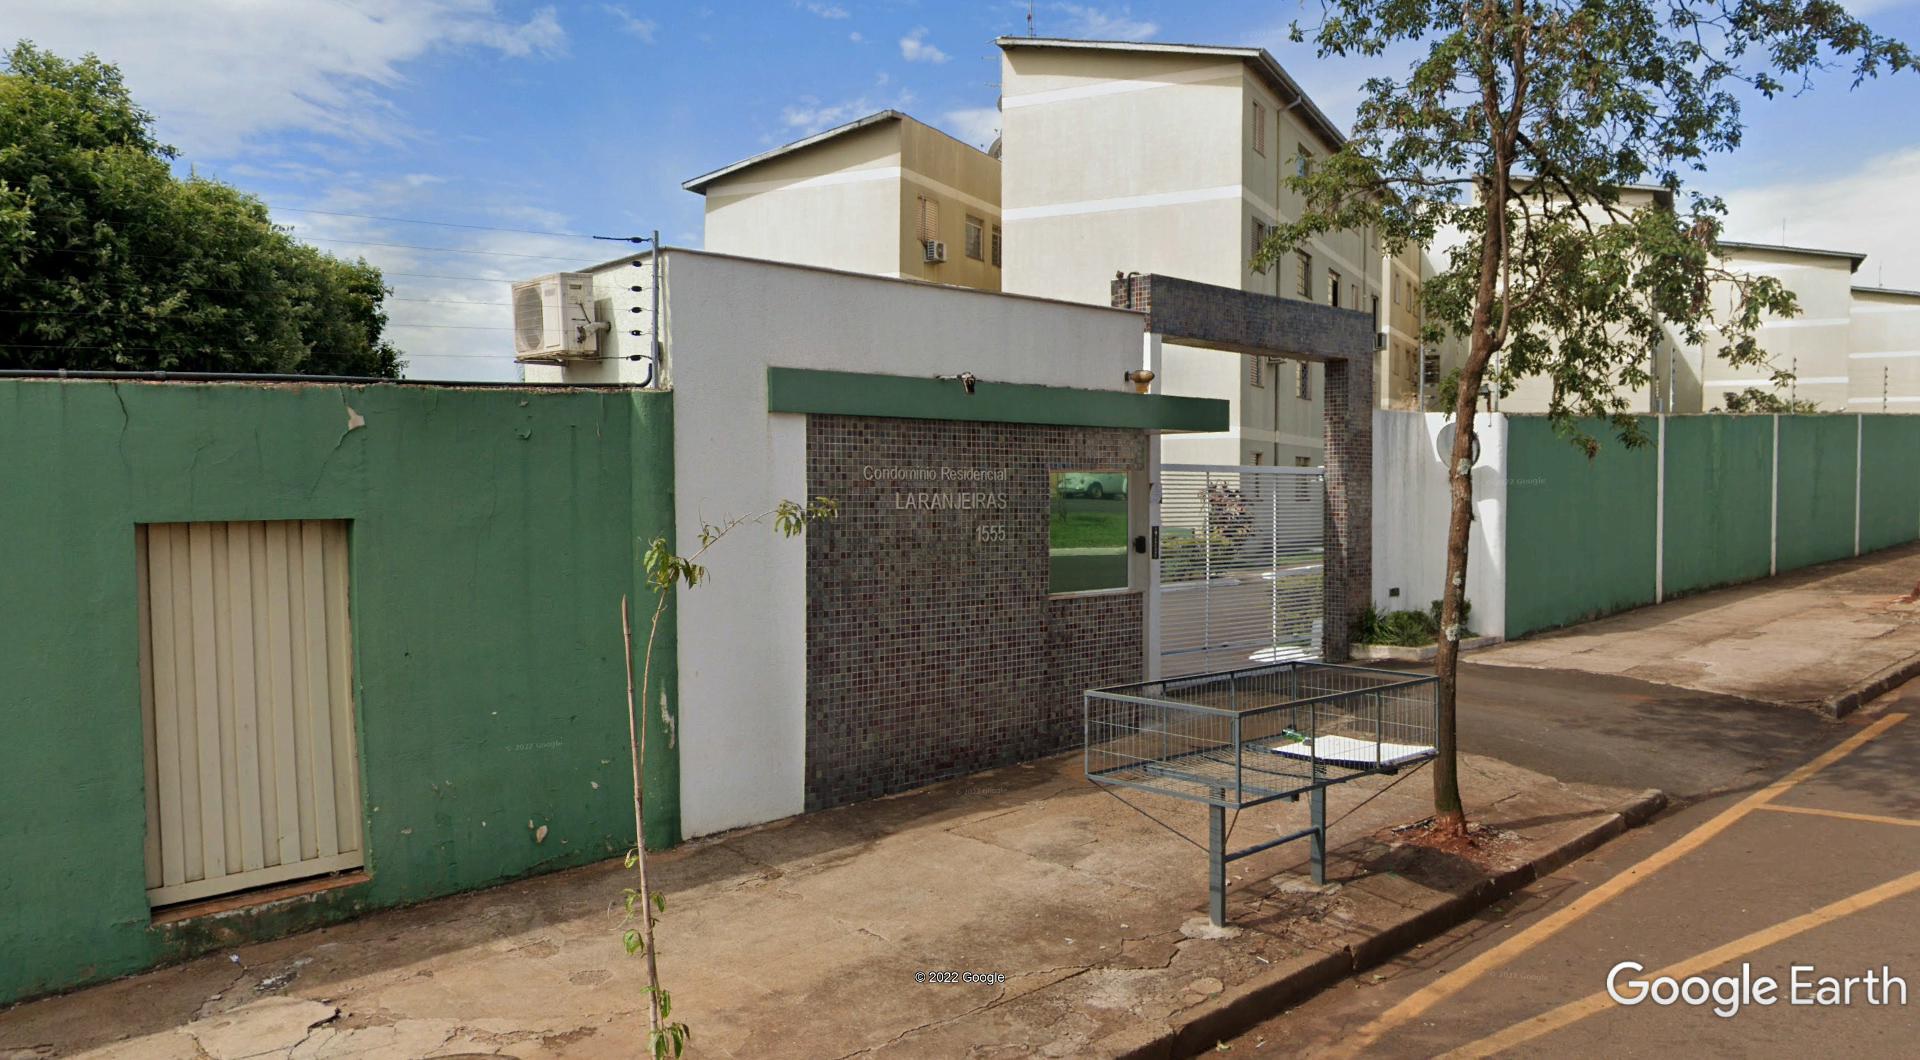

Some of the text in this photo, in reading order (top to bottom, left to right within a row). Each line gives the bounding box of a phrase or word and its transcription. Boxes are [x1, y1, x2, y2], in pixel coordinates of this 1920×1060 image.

[941, 466, 1007, 481] Residencial
[895, 492, 1007, 510] LARANJEIRAS
[975, 525, 1006, 543] 1555
